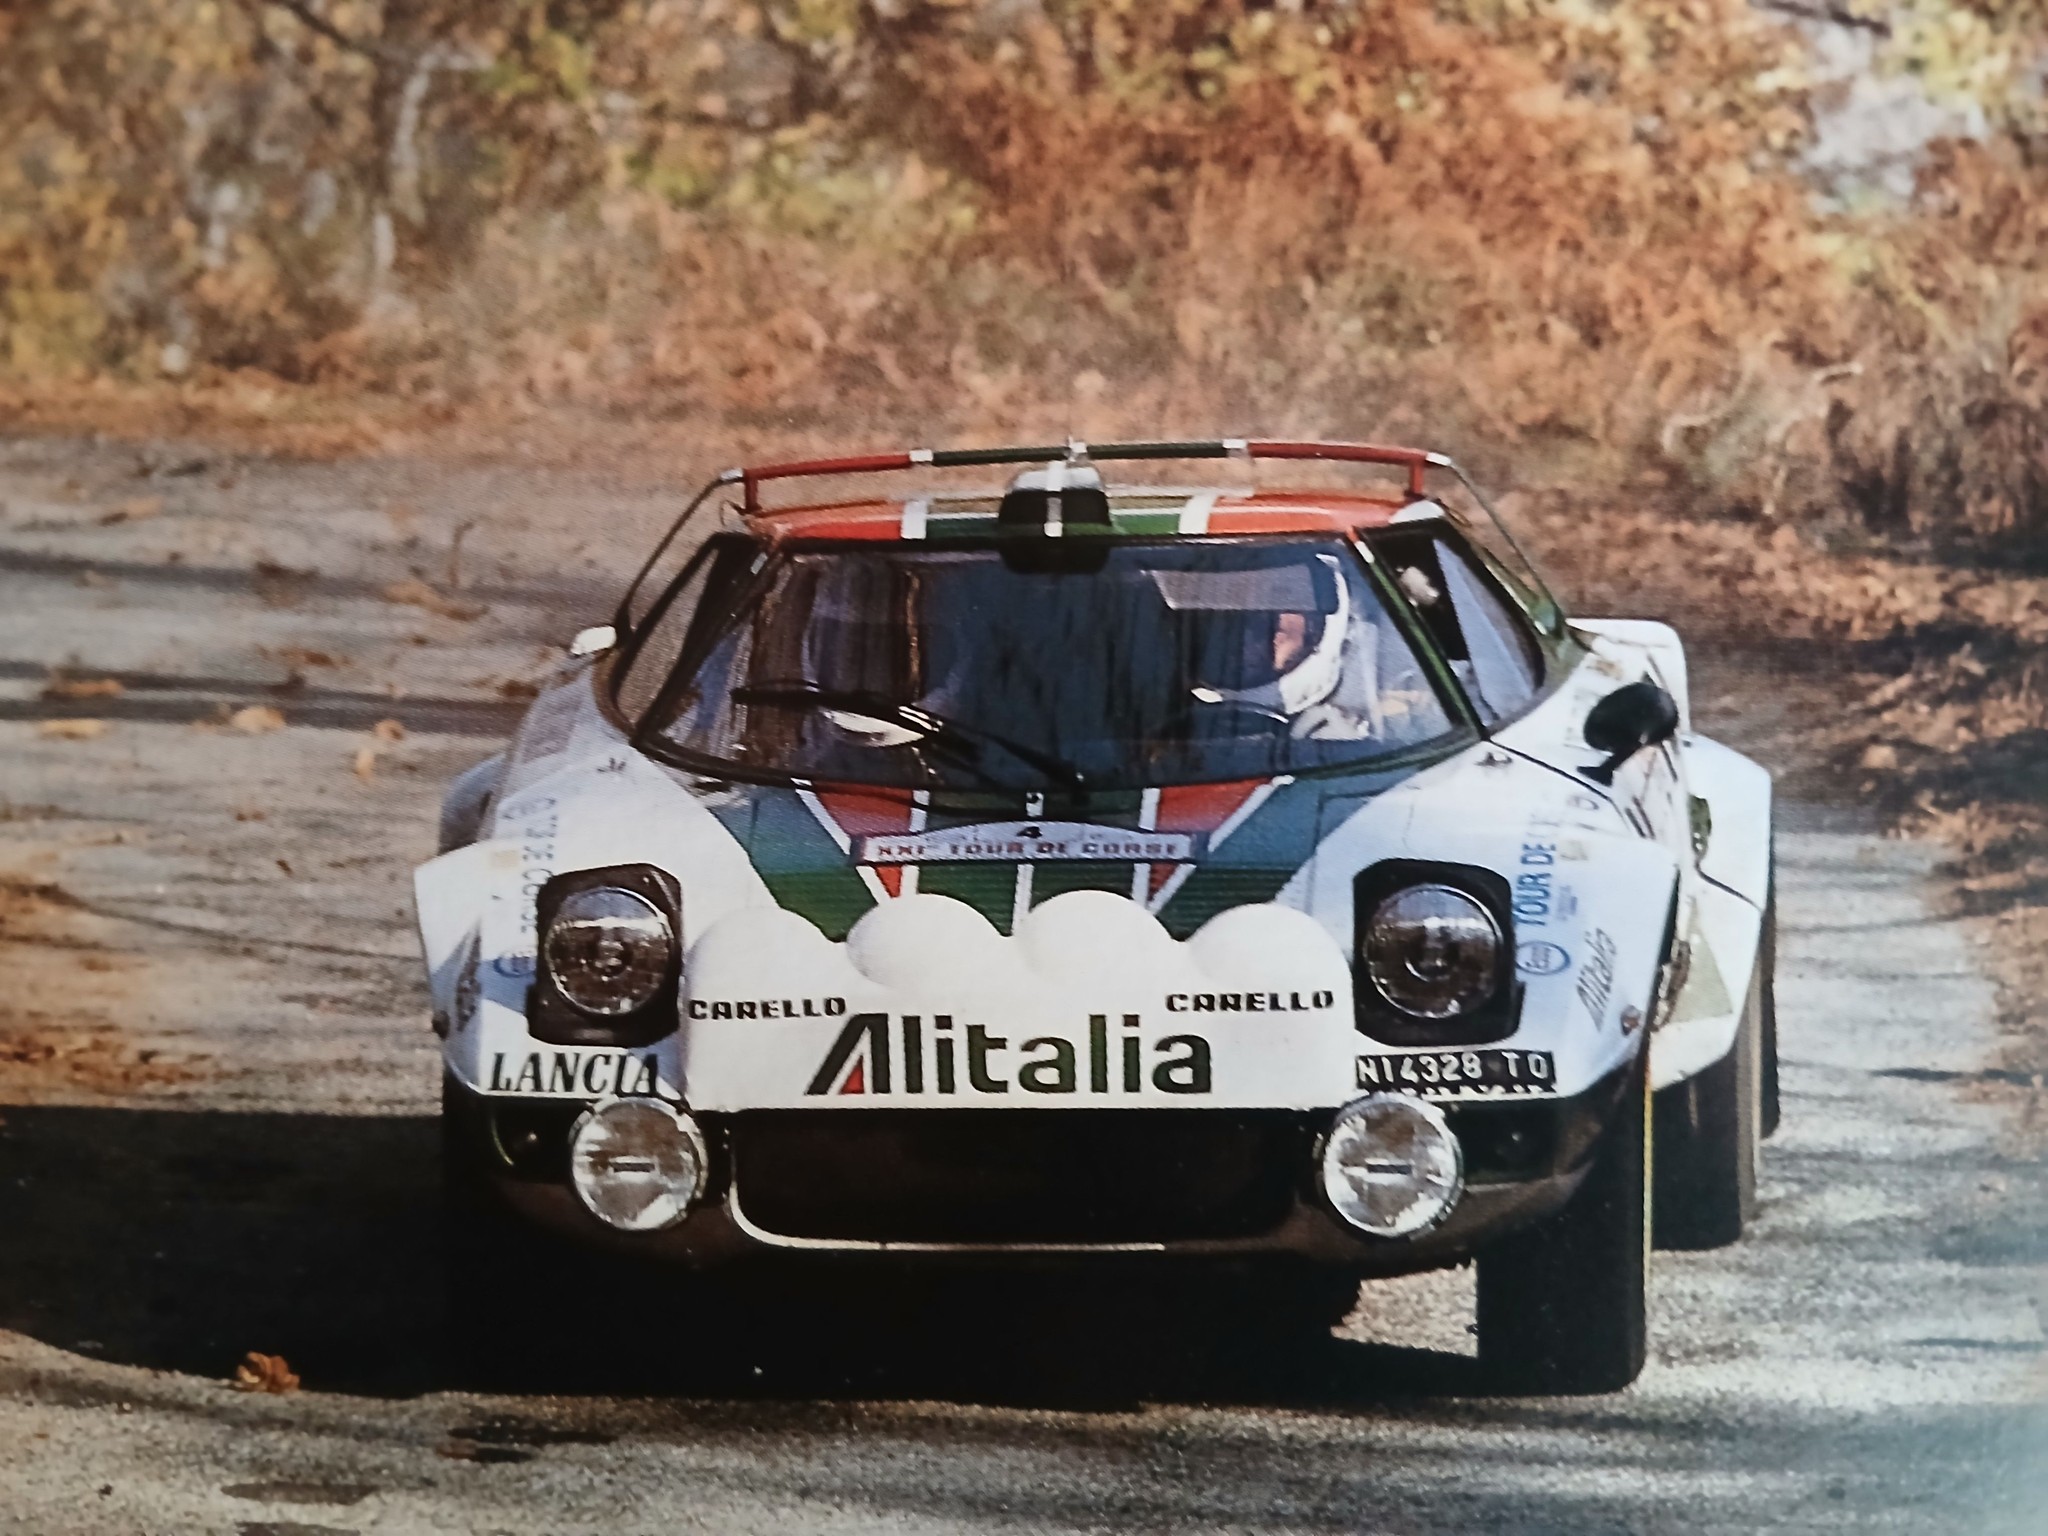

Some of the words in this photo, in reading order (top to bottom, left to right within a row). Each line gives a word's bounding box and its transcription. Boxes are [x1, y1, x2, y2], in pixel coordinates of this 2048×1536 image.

[950, 842, 1024, 855] TOUR
[1521, 843, 1557, 866] DE
[1513, 873, 1552, 926] TOUR
[688, 996, 847, 1020] CARELLO
[1166, 990, 1334, 1012] CARELLO
[803, 1012, 1212, 1096] Alitalia
[490, 1051, 660, 1097] LANCIA
